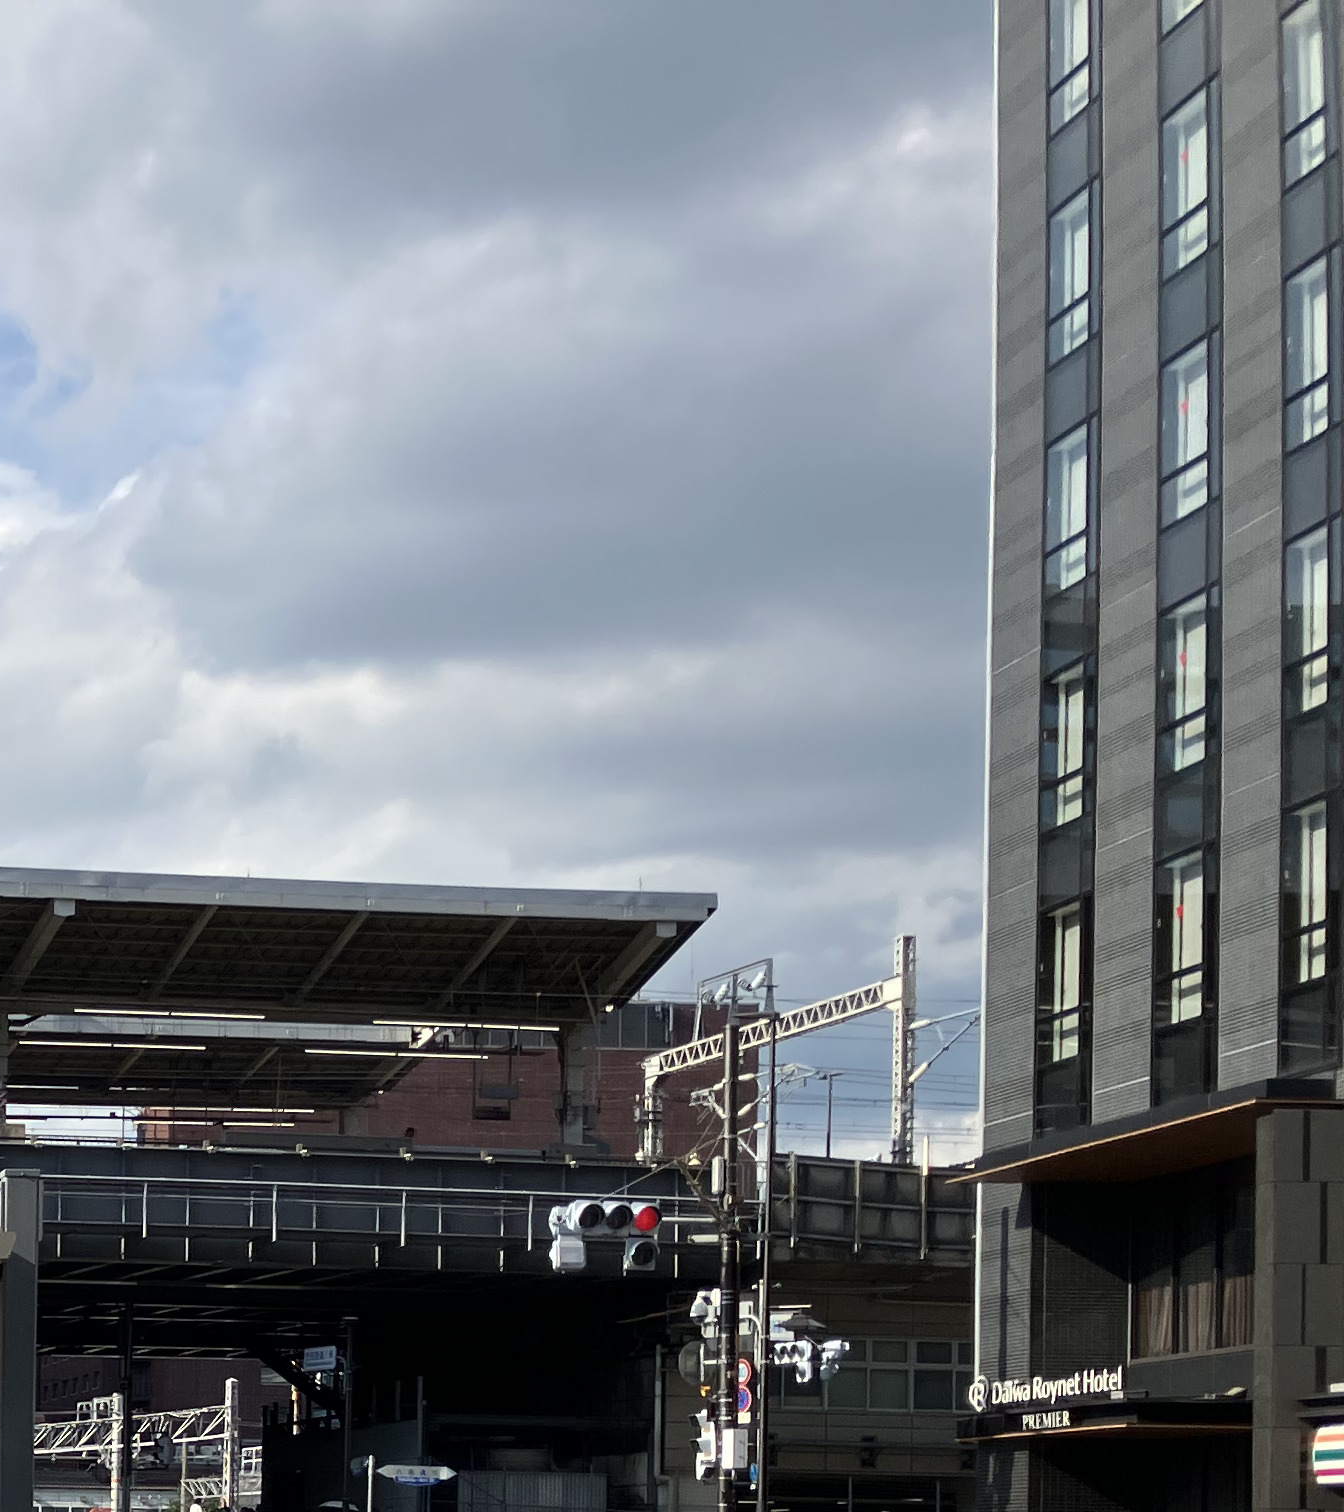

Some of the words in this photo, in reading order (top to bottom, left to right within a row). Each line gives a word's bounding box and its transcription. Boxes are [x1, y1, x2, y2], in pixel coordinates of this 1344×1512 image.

[991, 1379, 1031, 1405] Daiwa
[1032, 1371, 1082, 1405] Roynet
[1082, 1364, 1123, 1394] Hotel
[1022, 1410, 1071, 1432] PREMIER
